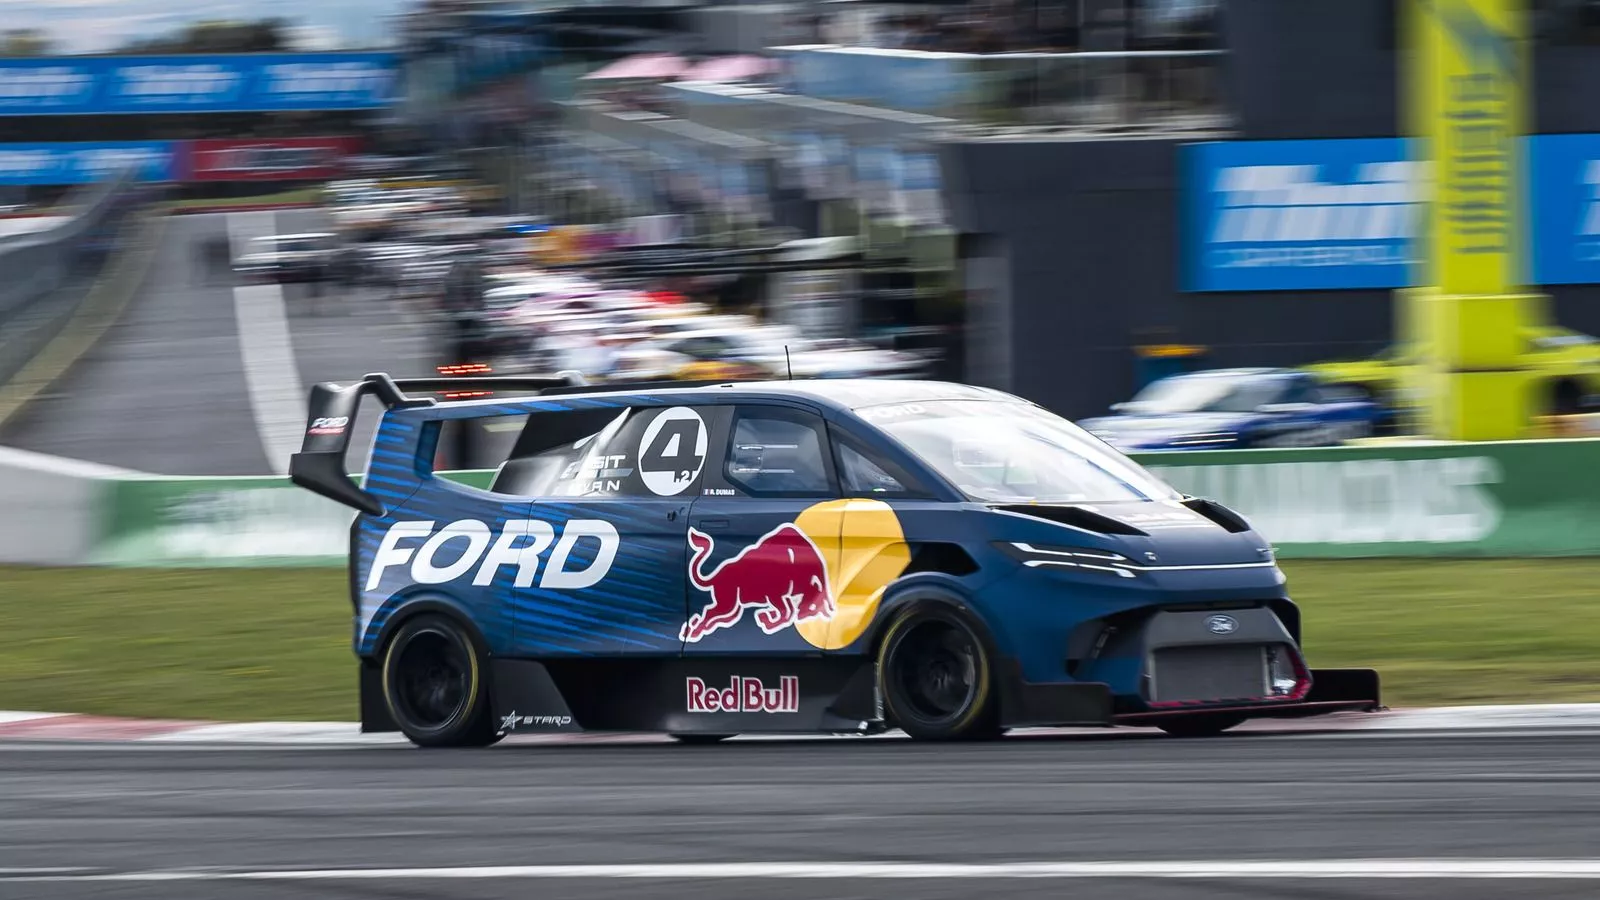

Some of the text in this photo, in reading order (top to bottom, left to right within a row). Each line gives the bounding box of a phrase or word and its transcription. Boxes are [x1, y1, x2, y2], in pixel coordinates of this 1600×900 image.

[365, 519, 620, 592] FORD
[686, 675, 799, 713] Red Bull
